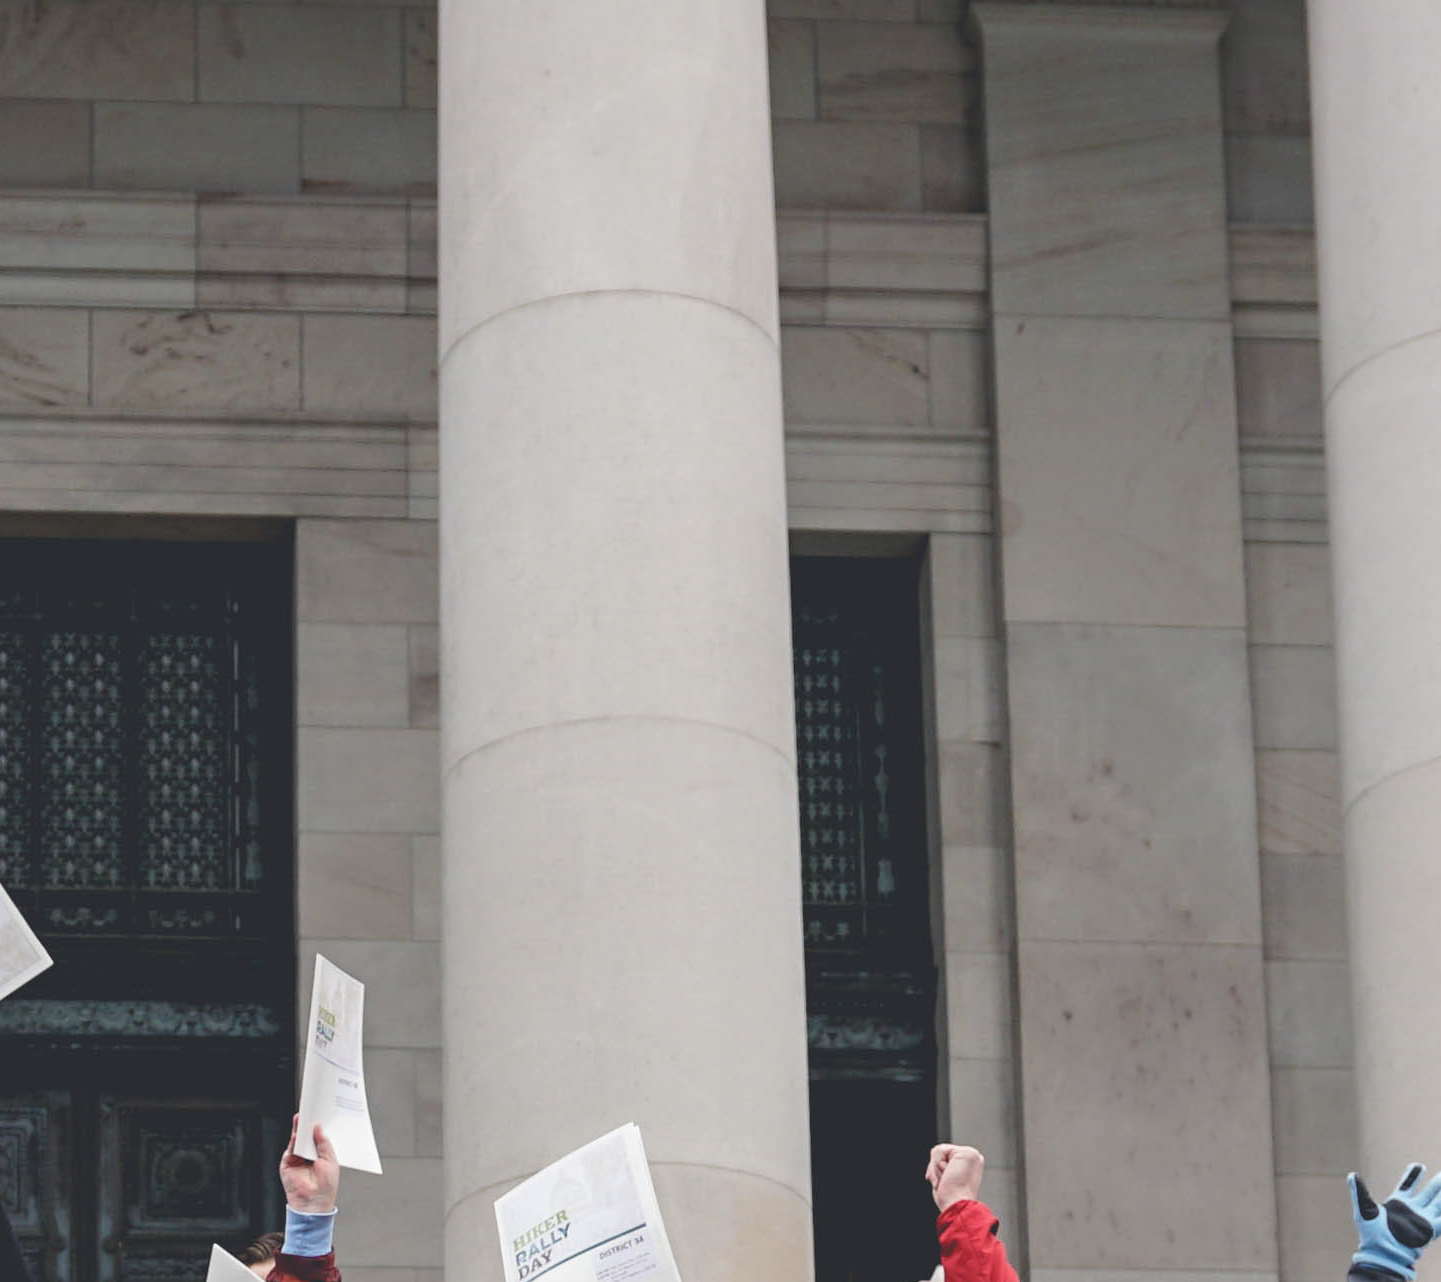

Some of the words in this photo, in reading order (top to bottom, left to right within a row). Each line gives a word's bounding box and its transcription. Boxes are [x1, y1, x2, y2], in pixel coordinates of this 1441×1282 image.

[512, 1209, 569, 1252] HIKER
[514, 1223, 571, 1266] RALLY
[517, 1250, 553, 1281] DAY
